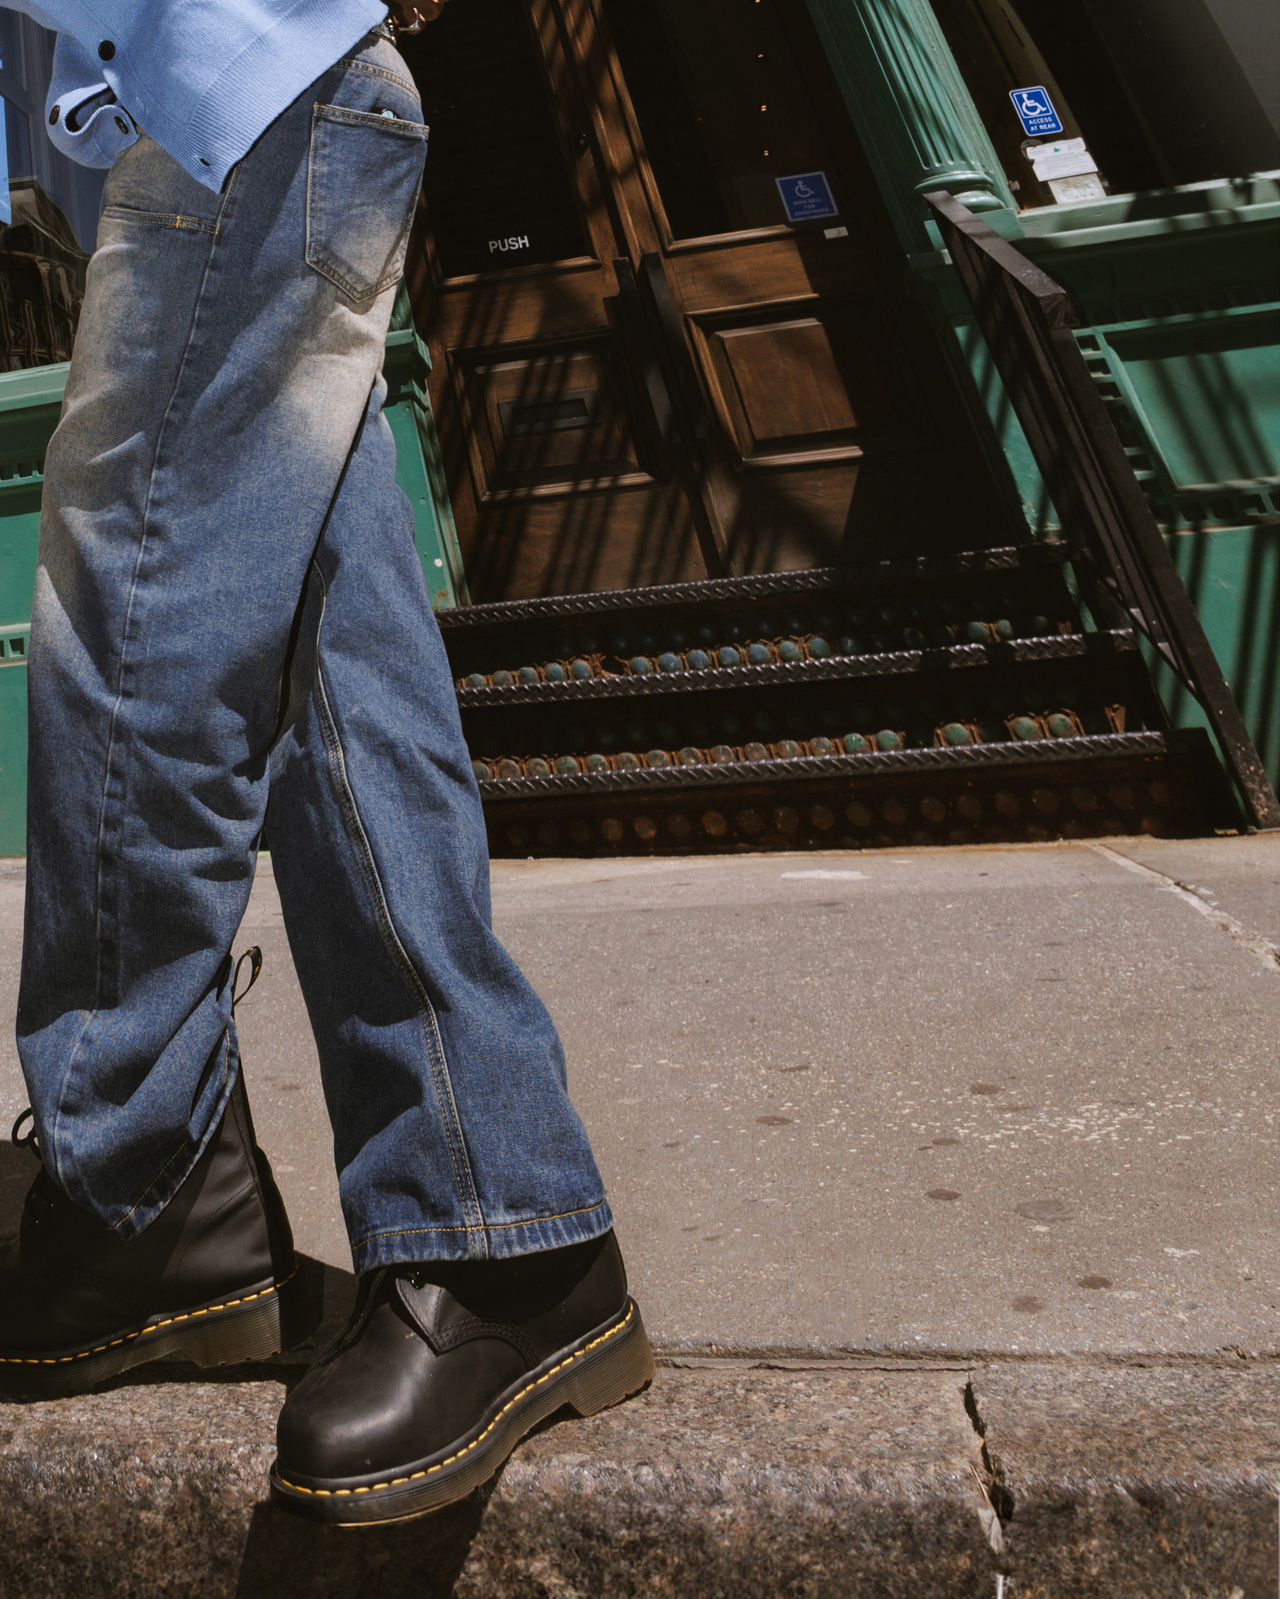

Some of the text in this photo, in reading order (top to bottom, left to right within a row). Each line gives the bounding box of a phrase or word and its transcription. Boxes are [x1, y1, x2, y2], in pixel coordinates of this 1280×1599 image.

[1028, 116, 1053, 125] ACCESS
[1039, 122, 1056, 130] REAR
[488, 235, 530, 254] PUSH
